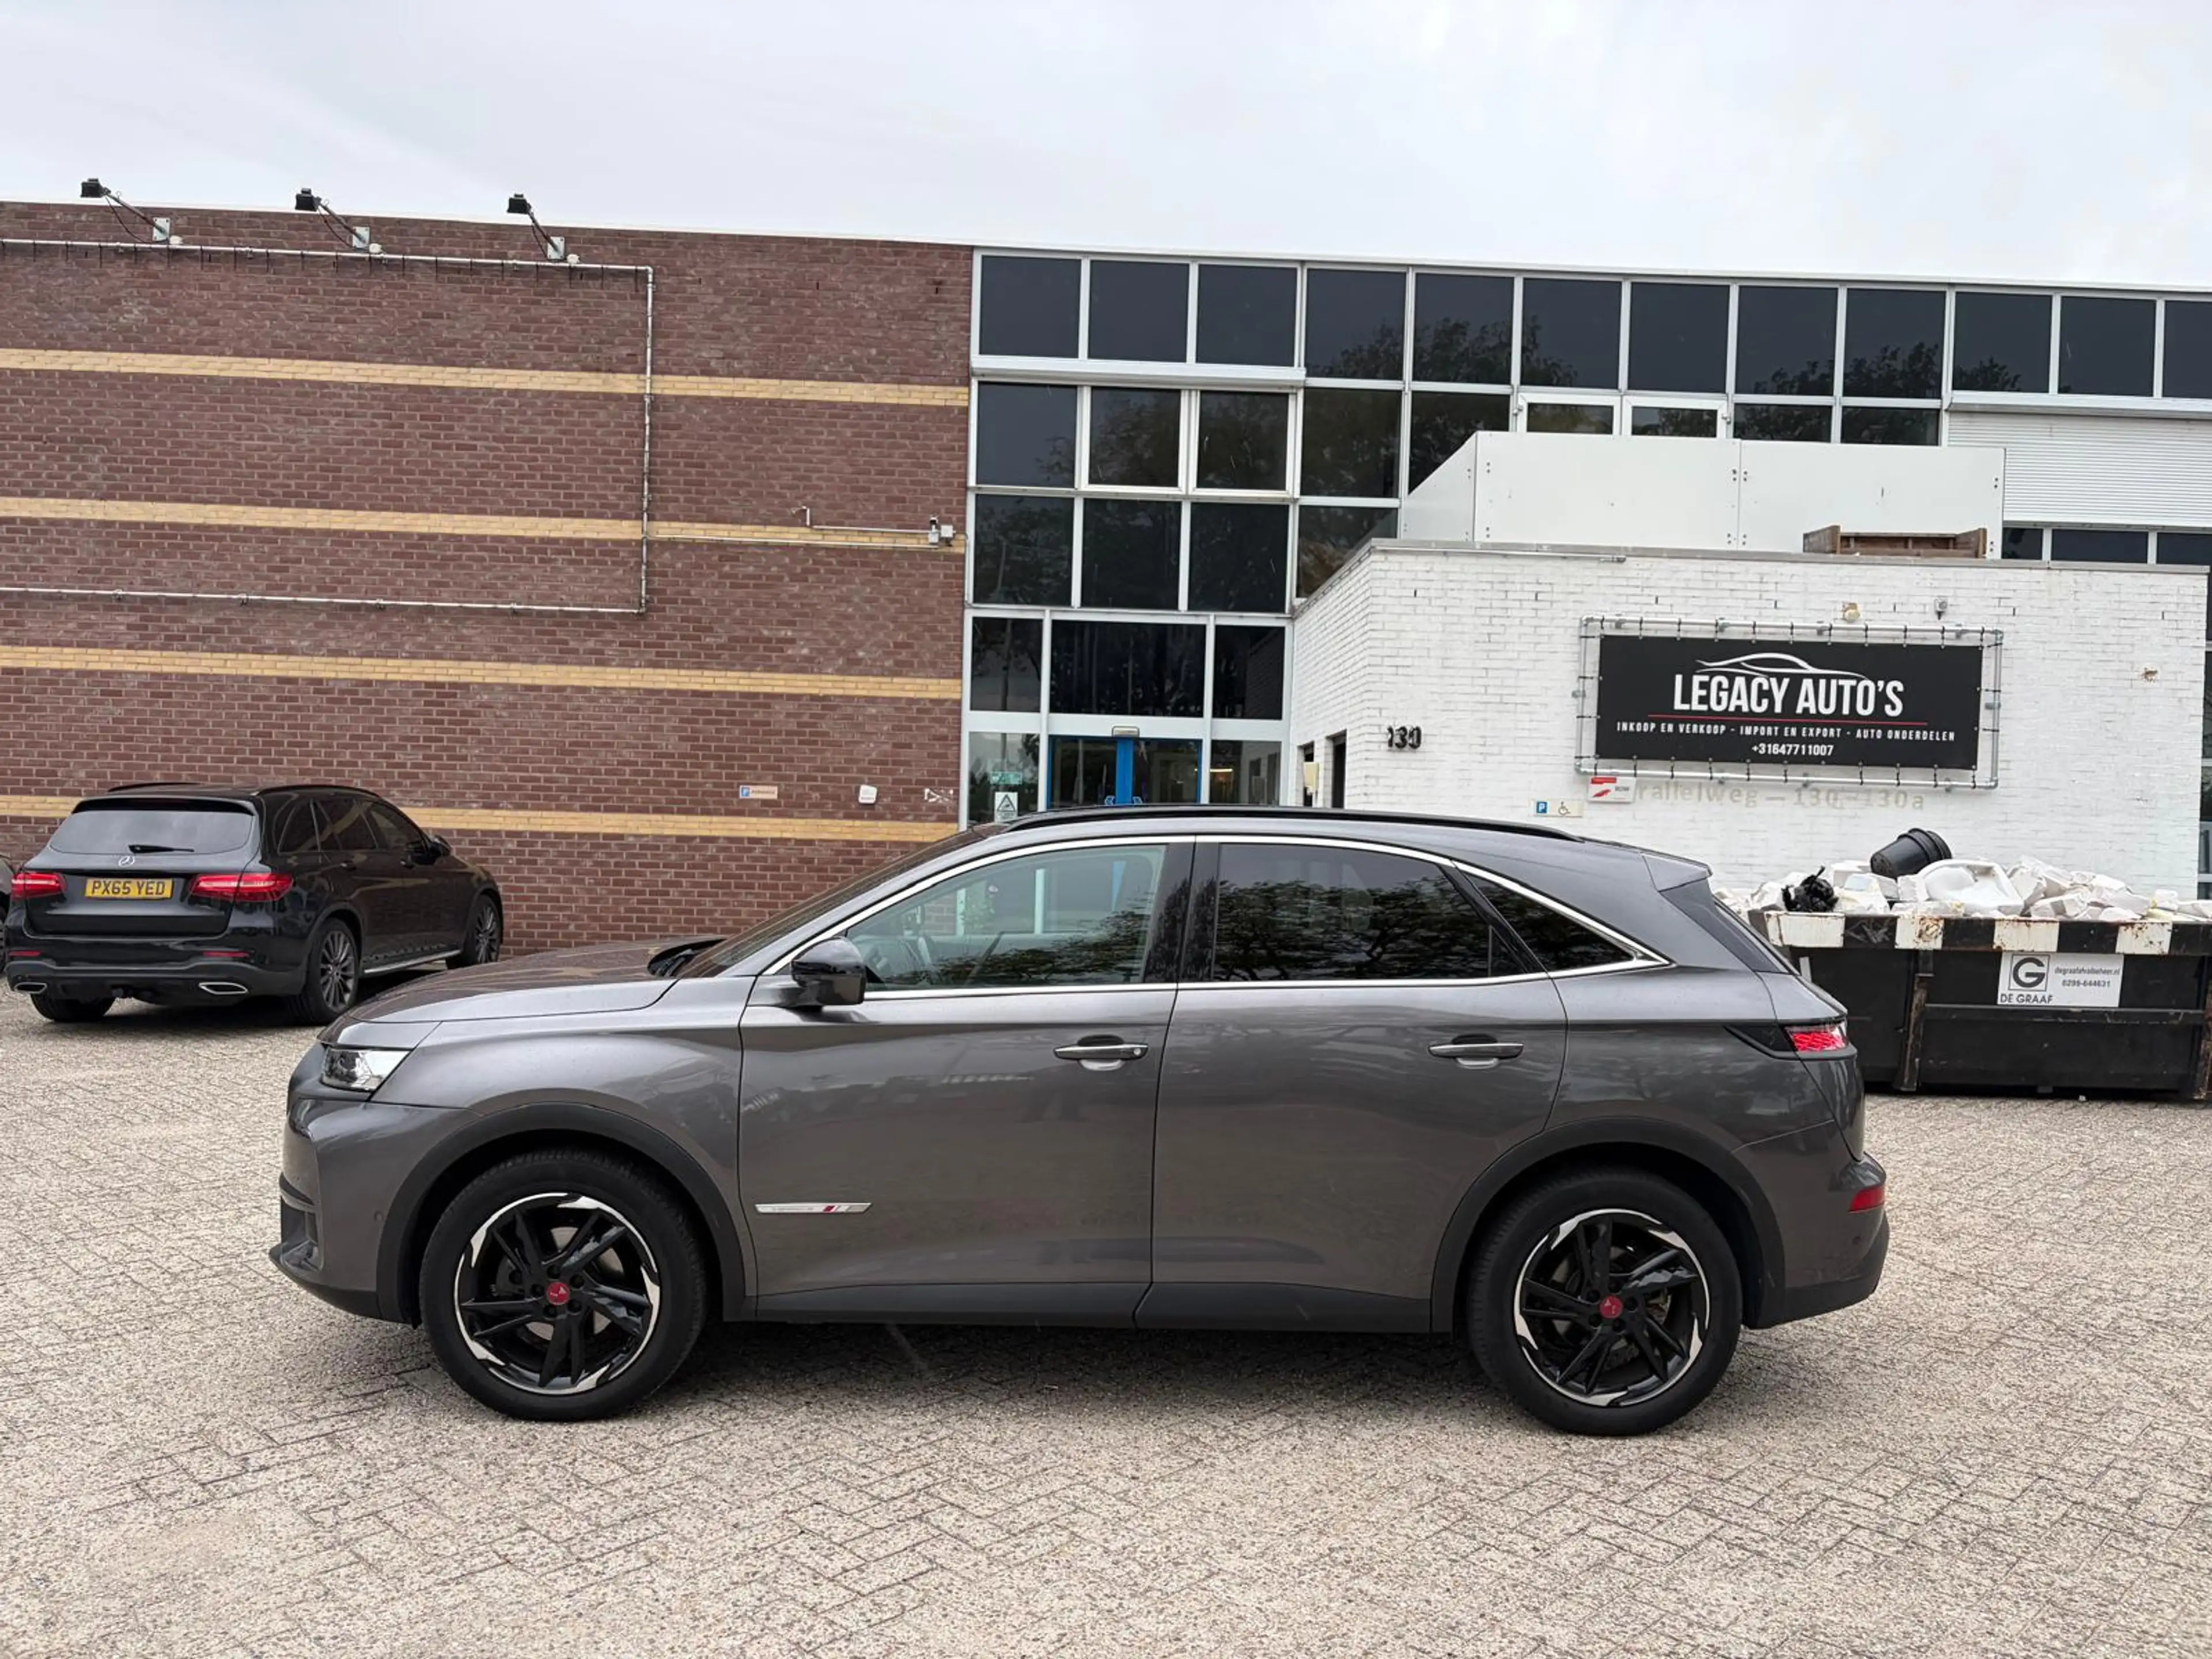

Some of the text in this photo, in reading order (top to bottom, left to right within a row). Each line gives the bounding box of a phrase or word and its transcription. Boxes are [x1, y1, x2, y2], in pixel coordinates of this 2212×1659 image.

[1673, 675, 1904, 717] LEGACY AUTO'S
[1387, 725, 1422, 749] 130
[1616, 722, 1656, 732] INKOOP
[1661, 723, 1674, 733] EN
[1679, 724, 1726, 734] VERKOOP
[1740, 725, 1779, 736] IMPORT
[1783, 727, 1797, 737] EN
[1801, 727, 1842, 738] EXPORT
[1855, 729, 1882, 739] AUTO
[1887, 730, 1956, 742] ONDERDELEN
[1751, 742, 1835, 756] +31647711007
[1638, 781, 1758, 808] rallelweg
[92, 880, 165, 895] PX65 YED
[2012, 956, 2046, 988] G
[2000, 993, 2054, 1004] DE GRAAF
